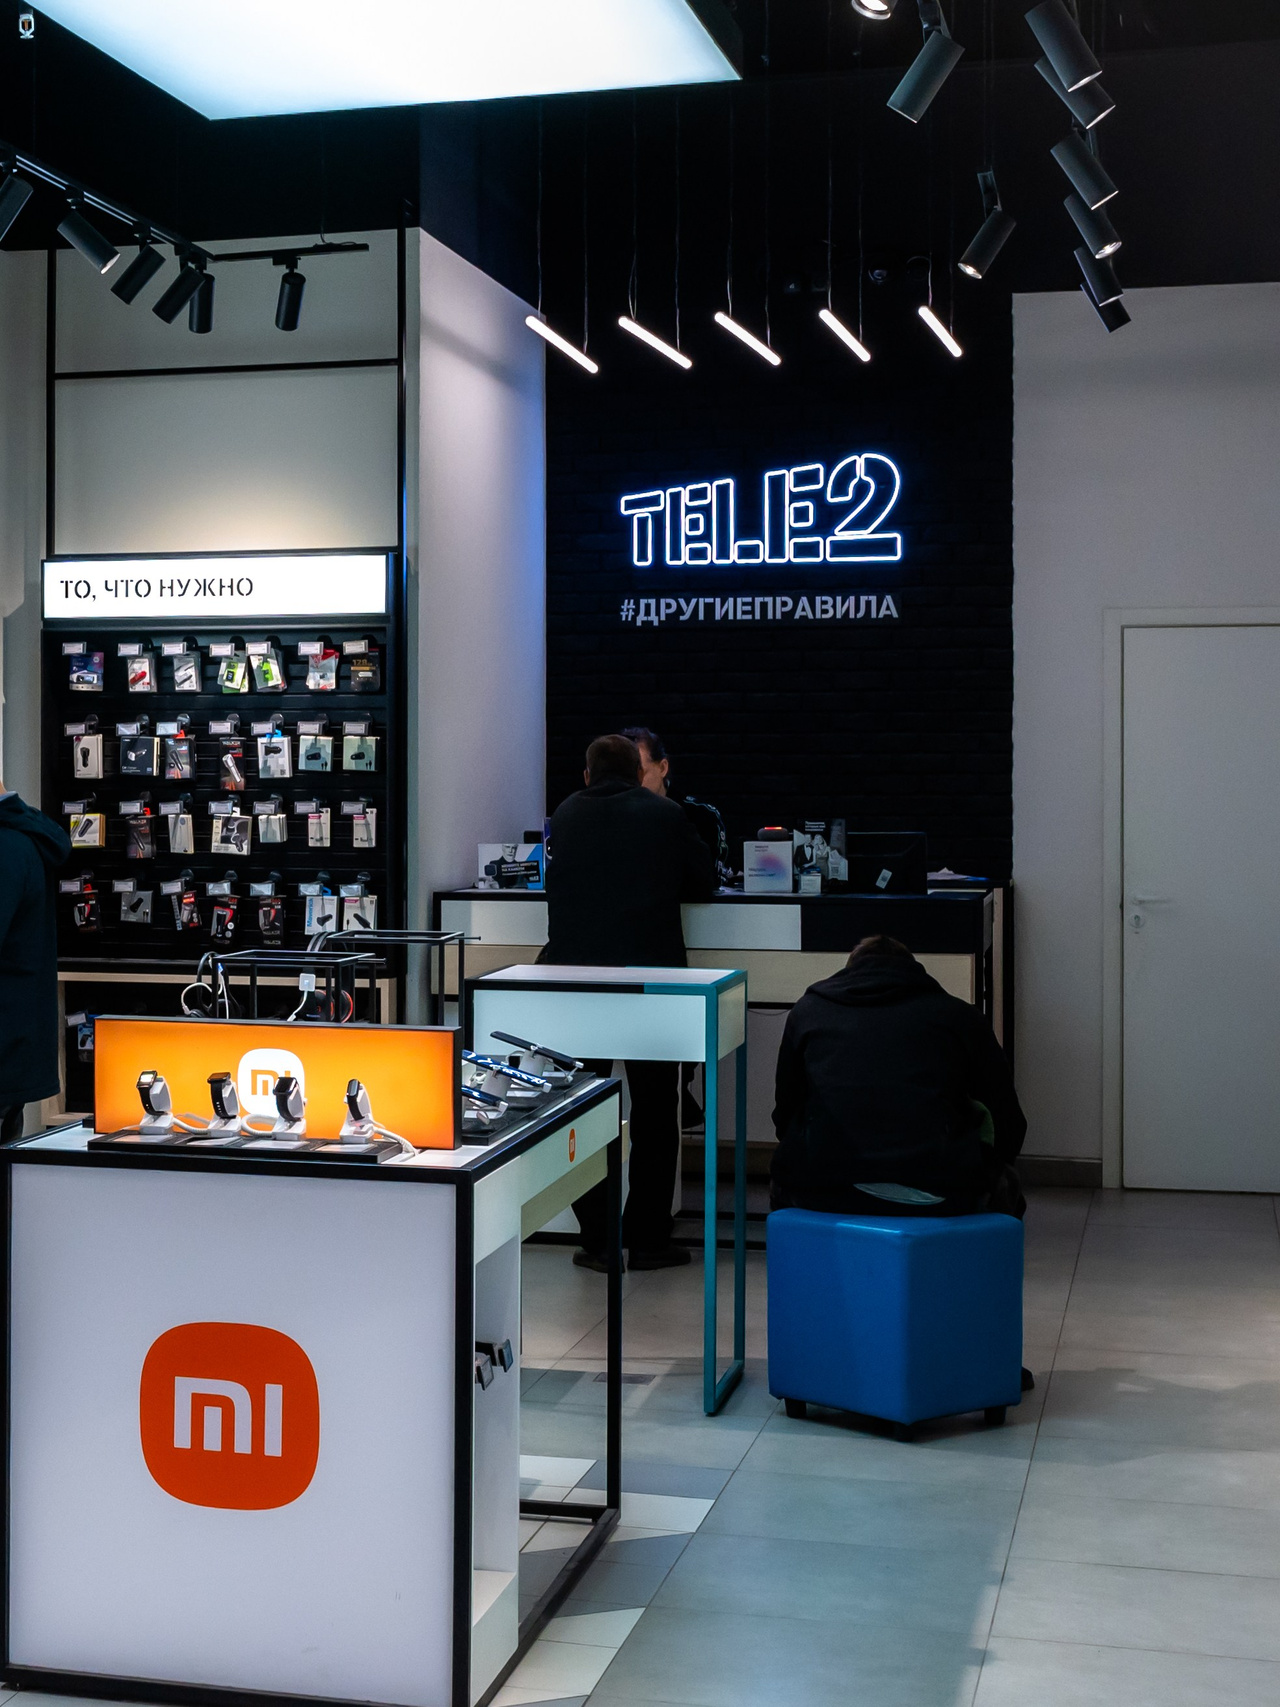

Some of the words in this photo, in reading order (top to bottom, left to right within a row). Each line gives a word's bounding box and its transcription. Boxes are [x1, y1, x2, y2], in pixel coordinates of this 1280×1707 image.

[620, 453, 902, 566] TELE2
[60, 579, 96, 602] ТО,
[104, 578, 152, 599] ЧТО
[159, 577, 254, 598] НУЖНО
[620, 595, 899, 626] #ДРУГИЕПРАВИЛА
